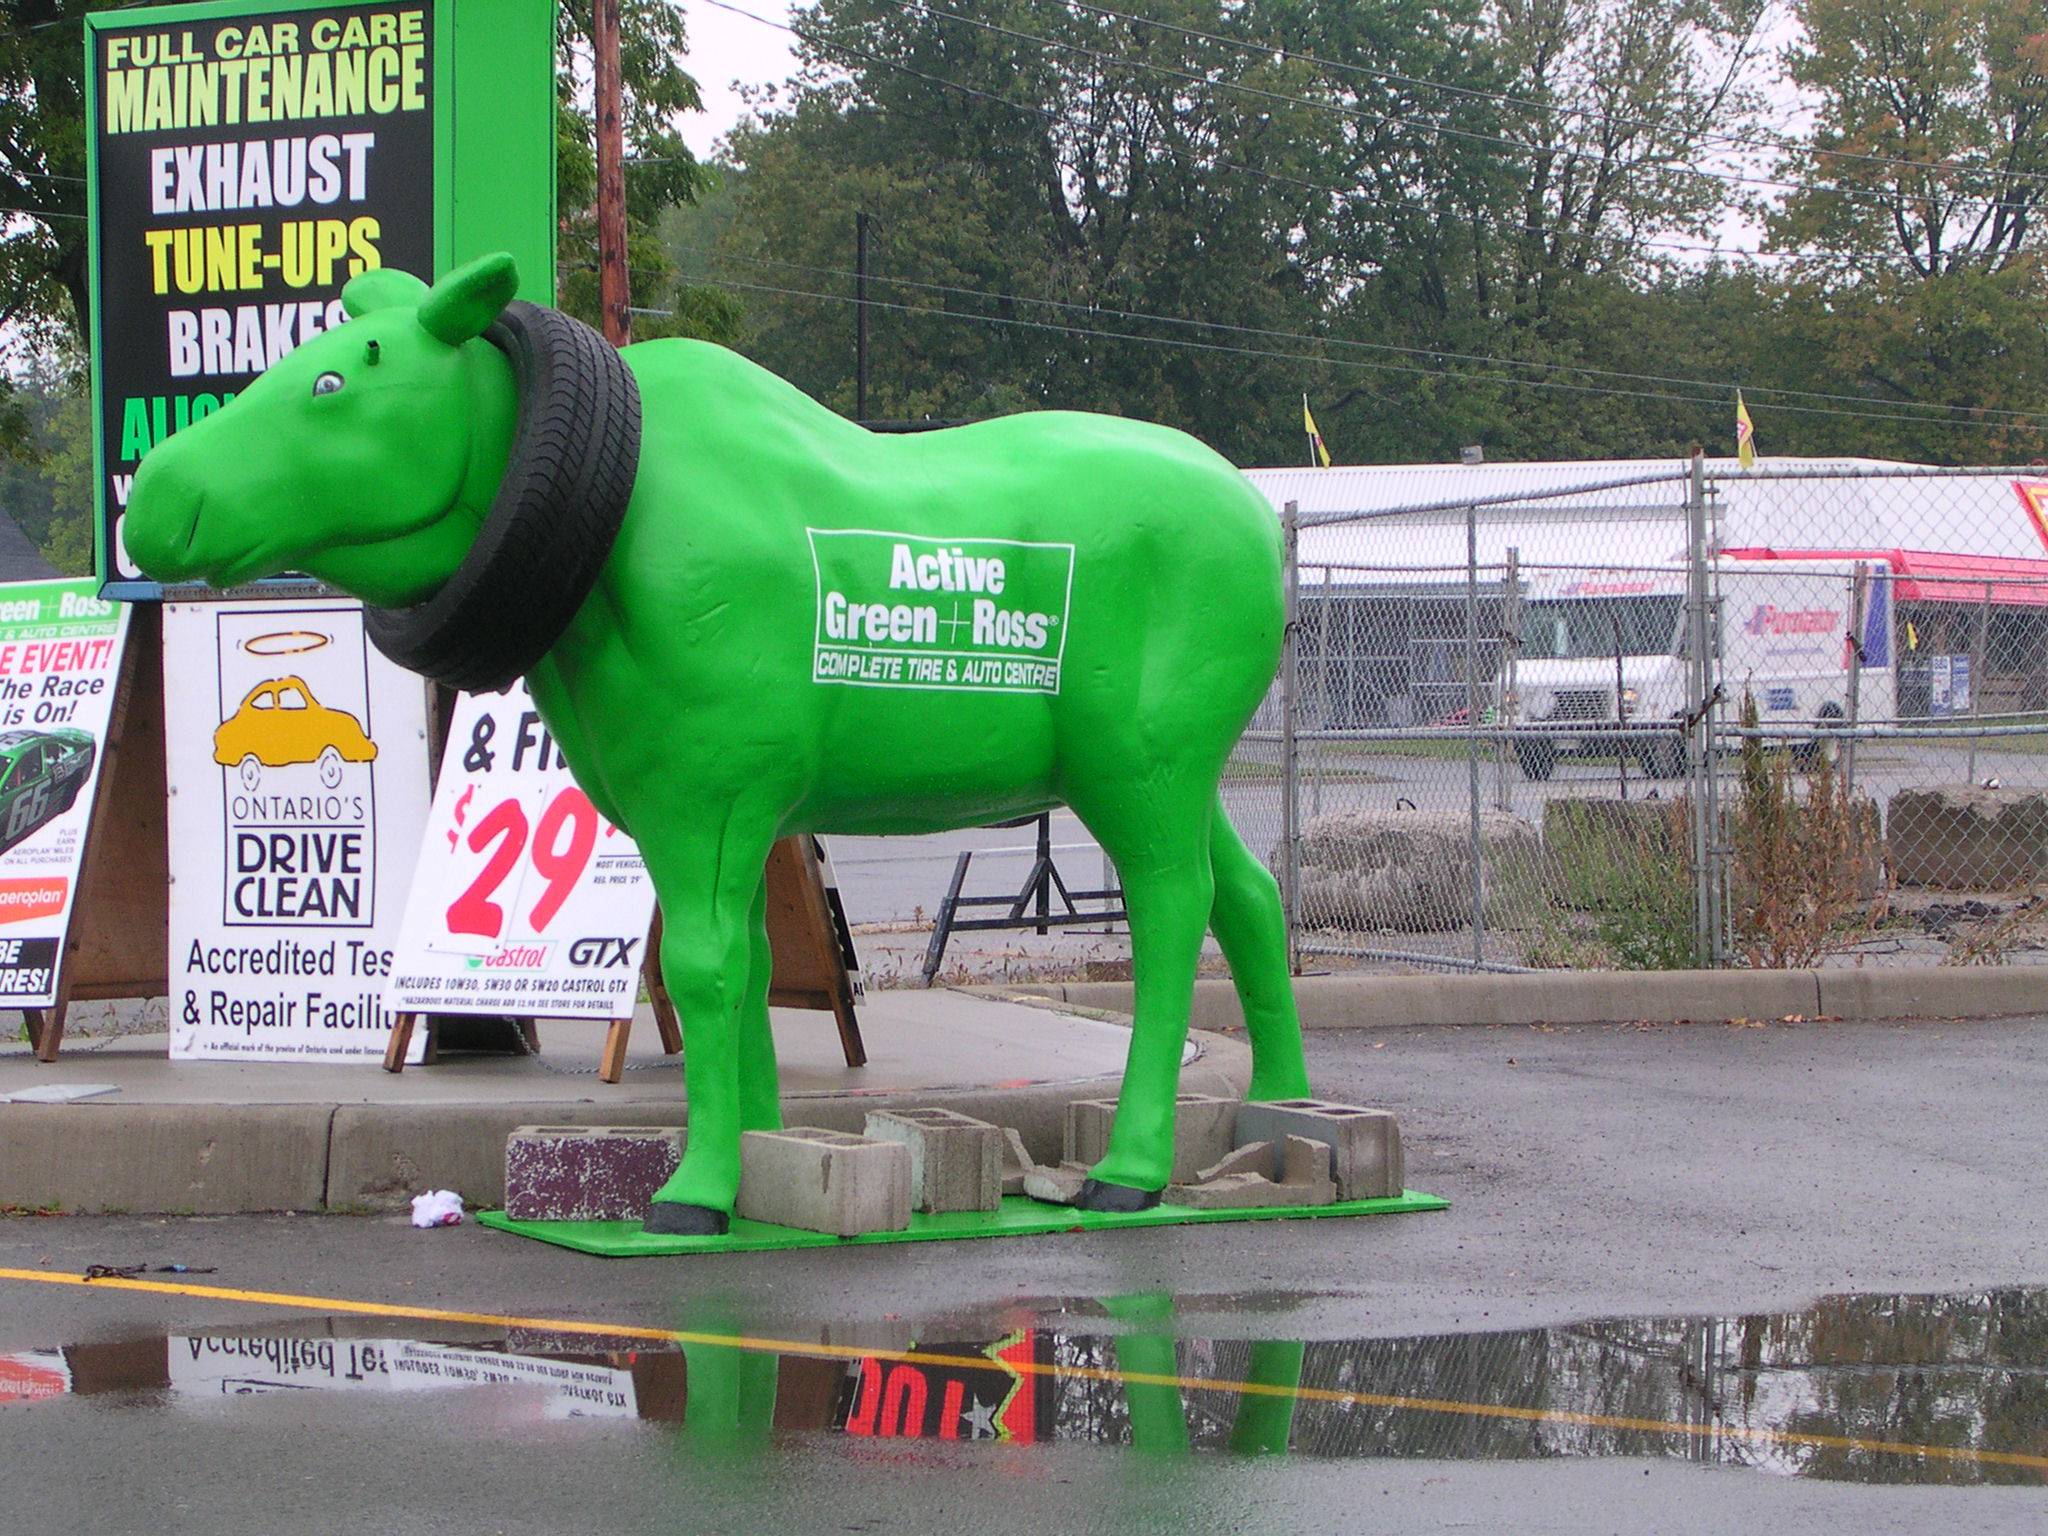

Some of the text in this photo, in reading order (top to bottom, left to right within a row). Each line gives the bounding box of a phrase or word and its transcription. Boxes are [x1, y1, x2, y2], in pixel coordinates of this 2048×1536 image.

[107, 10, 425, 70] FULL CAR CARE
[106, 44, 426, 135] MAINTENANCE
[151, 132, 375, 215] EXHAUST
[145, 217, 382, 296] TUNE-UPS
[889, 543, 1006, 594] Active
[59, 591, 112, 618] Ross
[825, 591, 938, 643] Green
[19, 639, 114, 674] EVENT!
[817, 652, 1058, 687] COMPLETE TIRE & AUTO CENTRE
[40, 674, 105, 698] Race
[2, 699, 78, 726] is On!
[464, 711, 568, 772] & FI
[5, 779, 52, 841] 66
[232, 795, 365, 820] ONTARIO'S
[237, 833, 362, 874] DRIVE
[234, 876, 360, 918] CLEAN
[186, 938, 336, 976] Accredited
[569, 937, 640, 969] GTX
[395, 976, 442, 990] INCLUDES
[484, 978, 512, 992] 5W30
[514, 978, 529, 992] OR
[531, 978, 560, 992] 5W20
[561, 978, 605, 993] CASTROL
[608, 979, 628, 993] GTX
[183, 989, 201, 1025] &
[211, 990, 296, 1036] Repair
